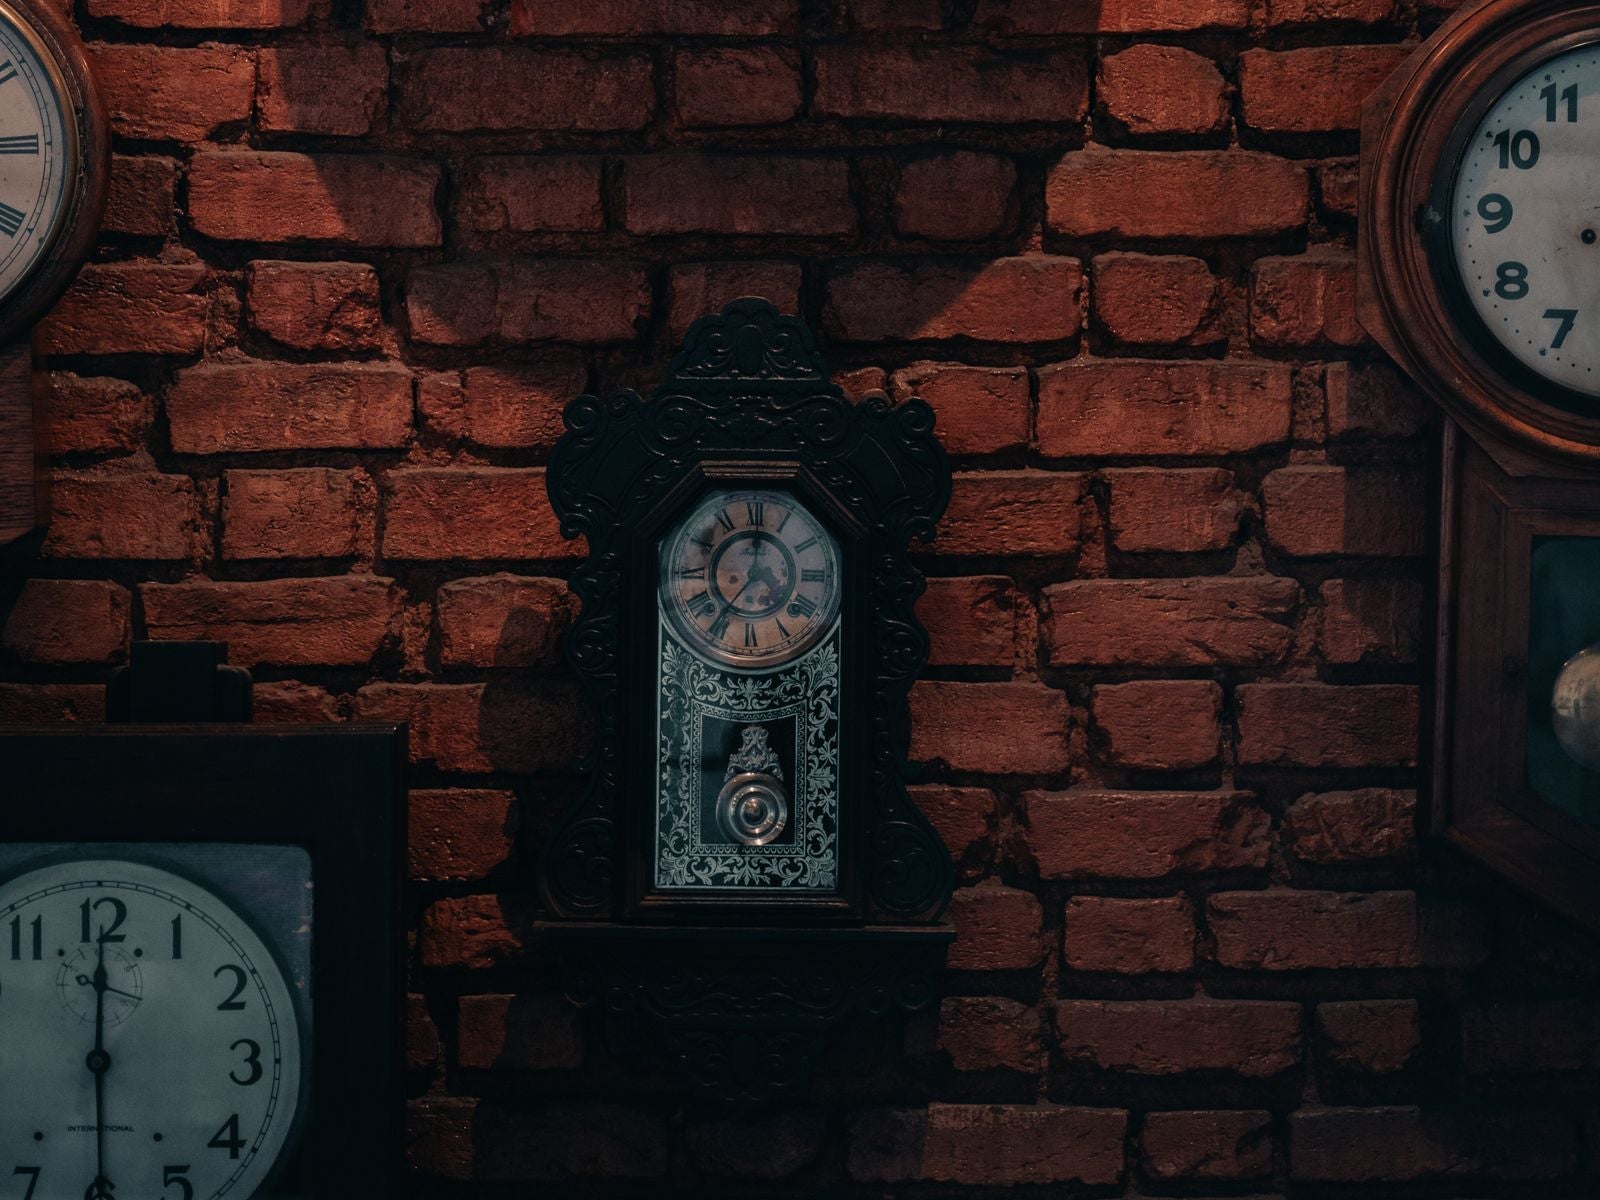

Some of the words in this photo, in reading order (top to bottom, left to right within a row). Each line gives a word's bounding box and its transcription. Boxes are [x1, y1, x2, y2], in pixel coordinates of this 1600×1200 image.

[1539, 83, 1578, 123] 11
[1492, 129, 1540, 170] 10
[1477, 193, 1513, 234] 9
[1494, 261, 1529, 300] 8
[1542, 309, 1578, 349] 7
[9, 914, 42, 961] 11
[79, 897, 127, 943] 12
[171, 913, 182, 960] 1
[214, 964, 247, 1011] 2
[229, 1038, 263, 1086] 3
[207, 1113, 247, 1160] 4
[13, 1166, 41, 1200] 7
[160, 1164, 194, 1200] 5
